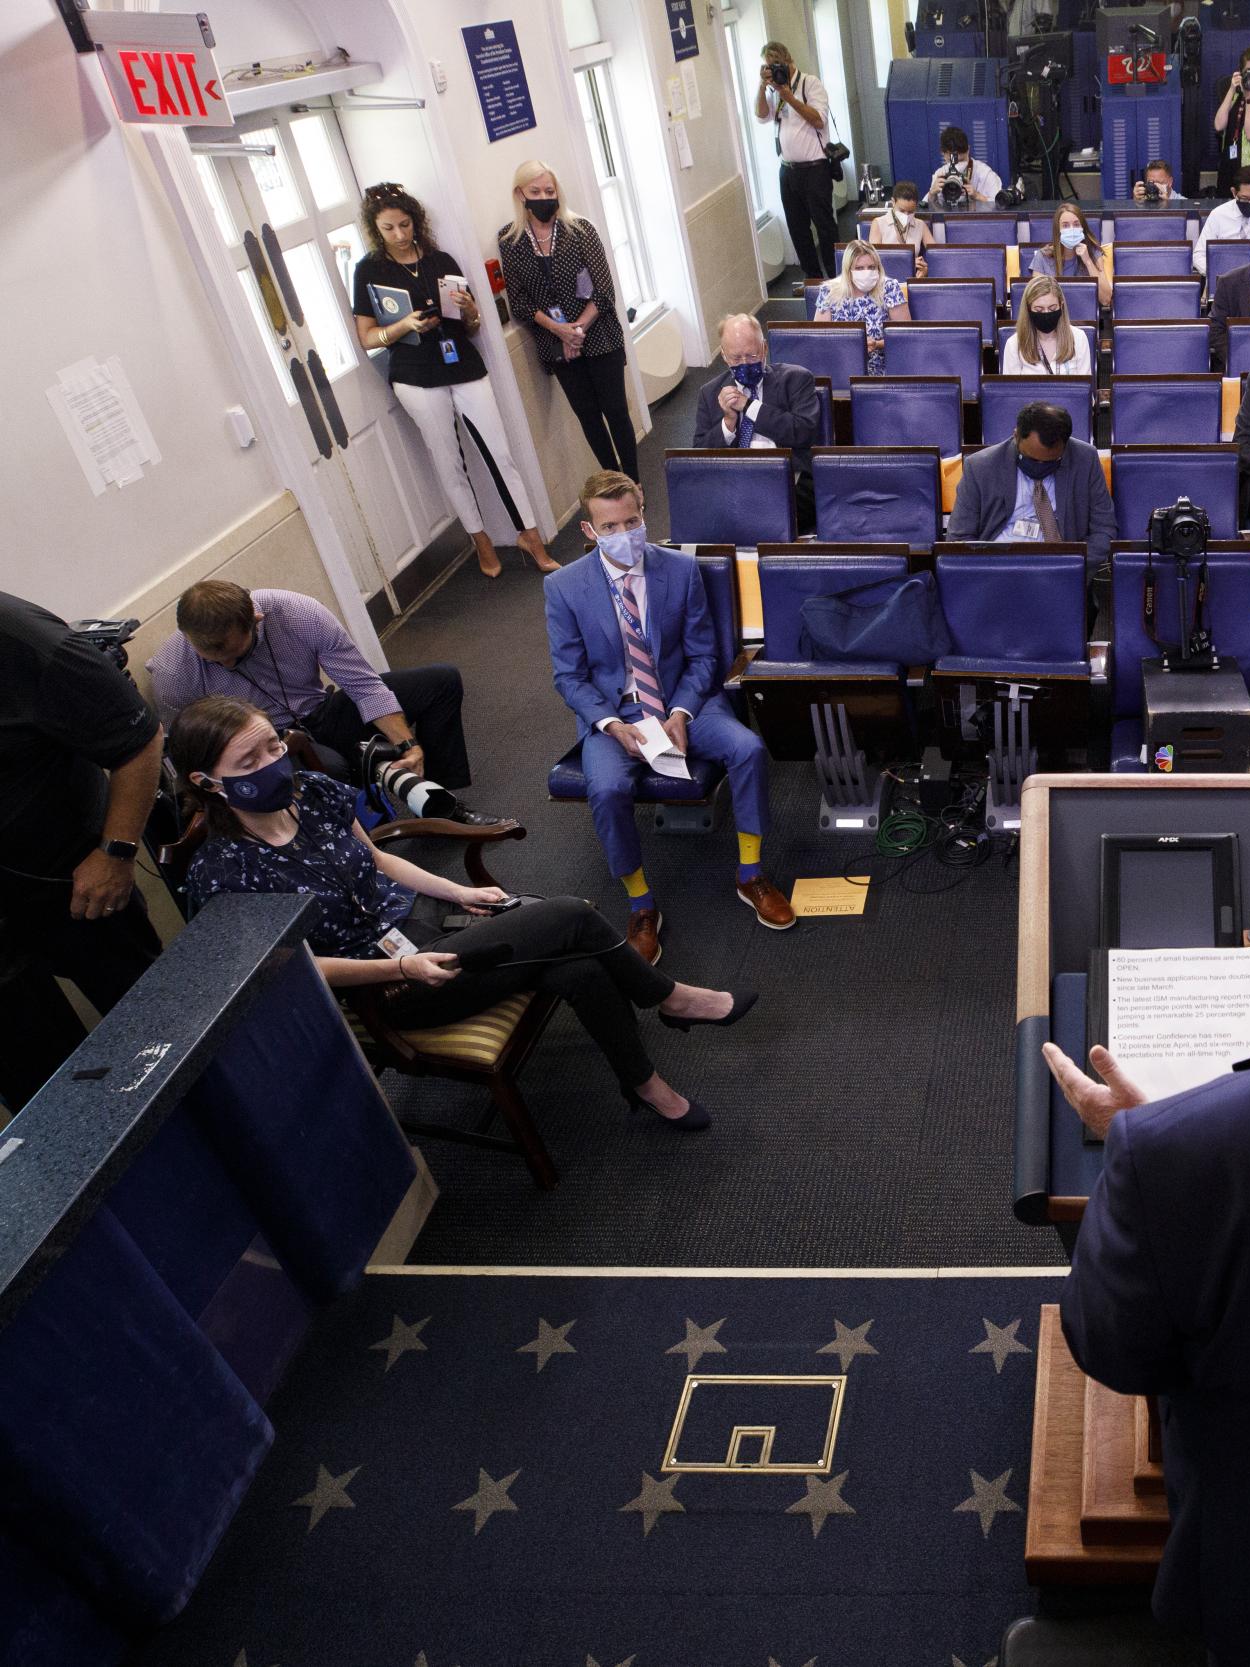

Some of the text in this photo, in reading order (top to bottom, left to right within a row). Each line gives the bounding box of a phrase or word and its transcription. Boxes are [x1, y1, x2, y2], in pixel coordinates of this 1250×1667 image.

[118, 51, 208, 116] EXIT
[803, 905, 855, 913] ATTENTION
[1206, 1011, 1246, 1019] percentage
[1129, 1042, 1150, 1050] points
